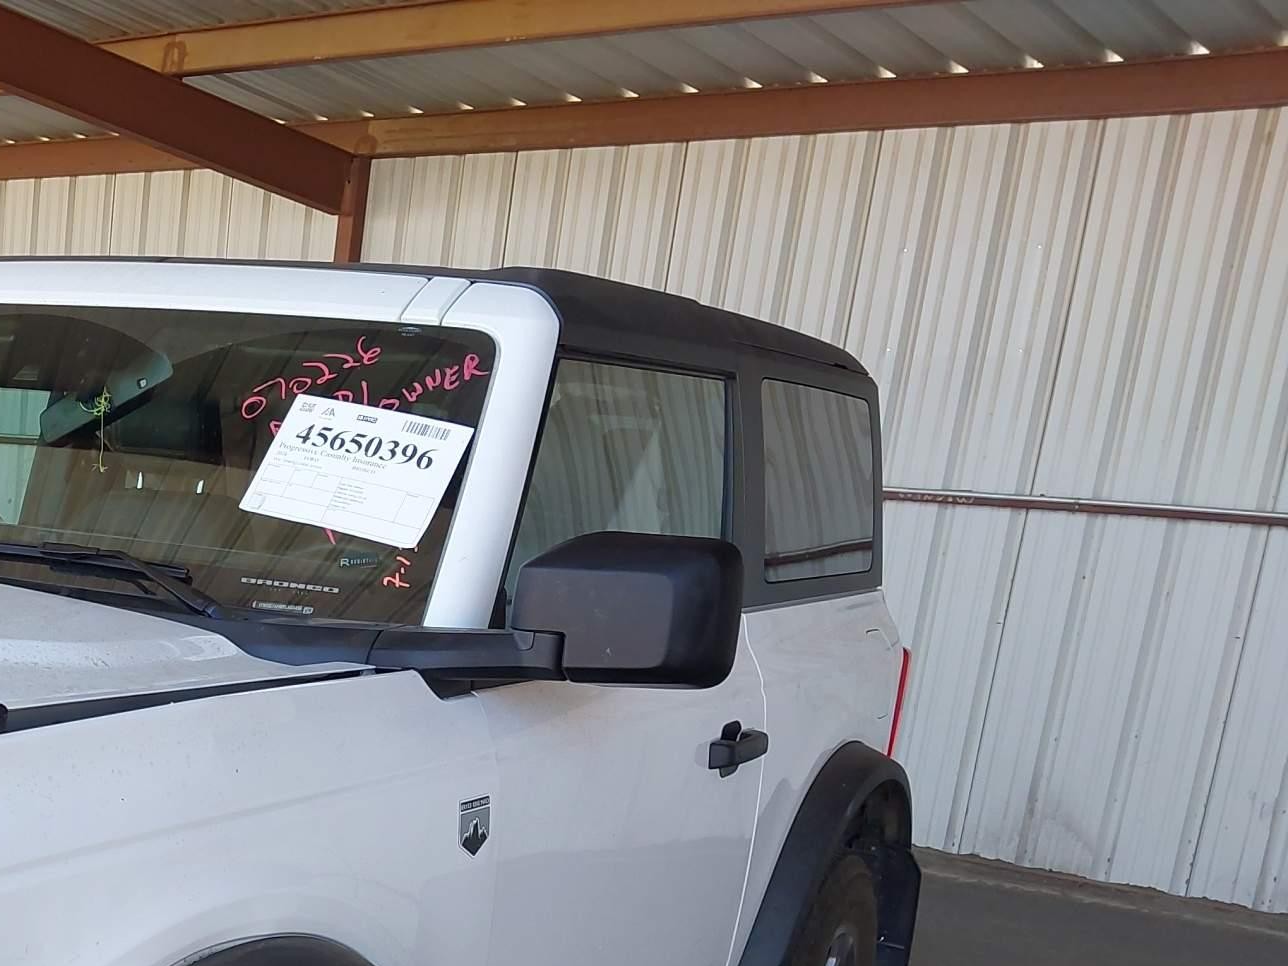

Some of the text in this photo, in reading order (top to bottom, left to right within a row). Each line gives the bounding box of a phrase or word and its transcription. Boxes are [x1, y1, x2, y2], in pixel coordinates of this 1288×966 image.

[241, 336, 381, 419] 070226
[279, 442, 318, 456] Progressive
[320, 449, 351, 462] Casualty
[352, 457, 388, 470] Insurance
[295, 423, 440, 470] 45650396
[241, 577, 340, 593] BRONCO
